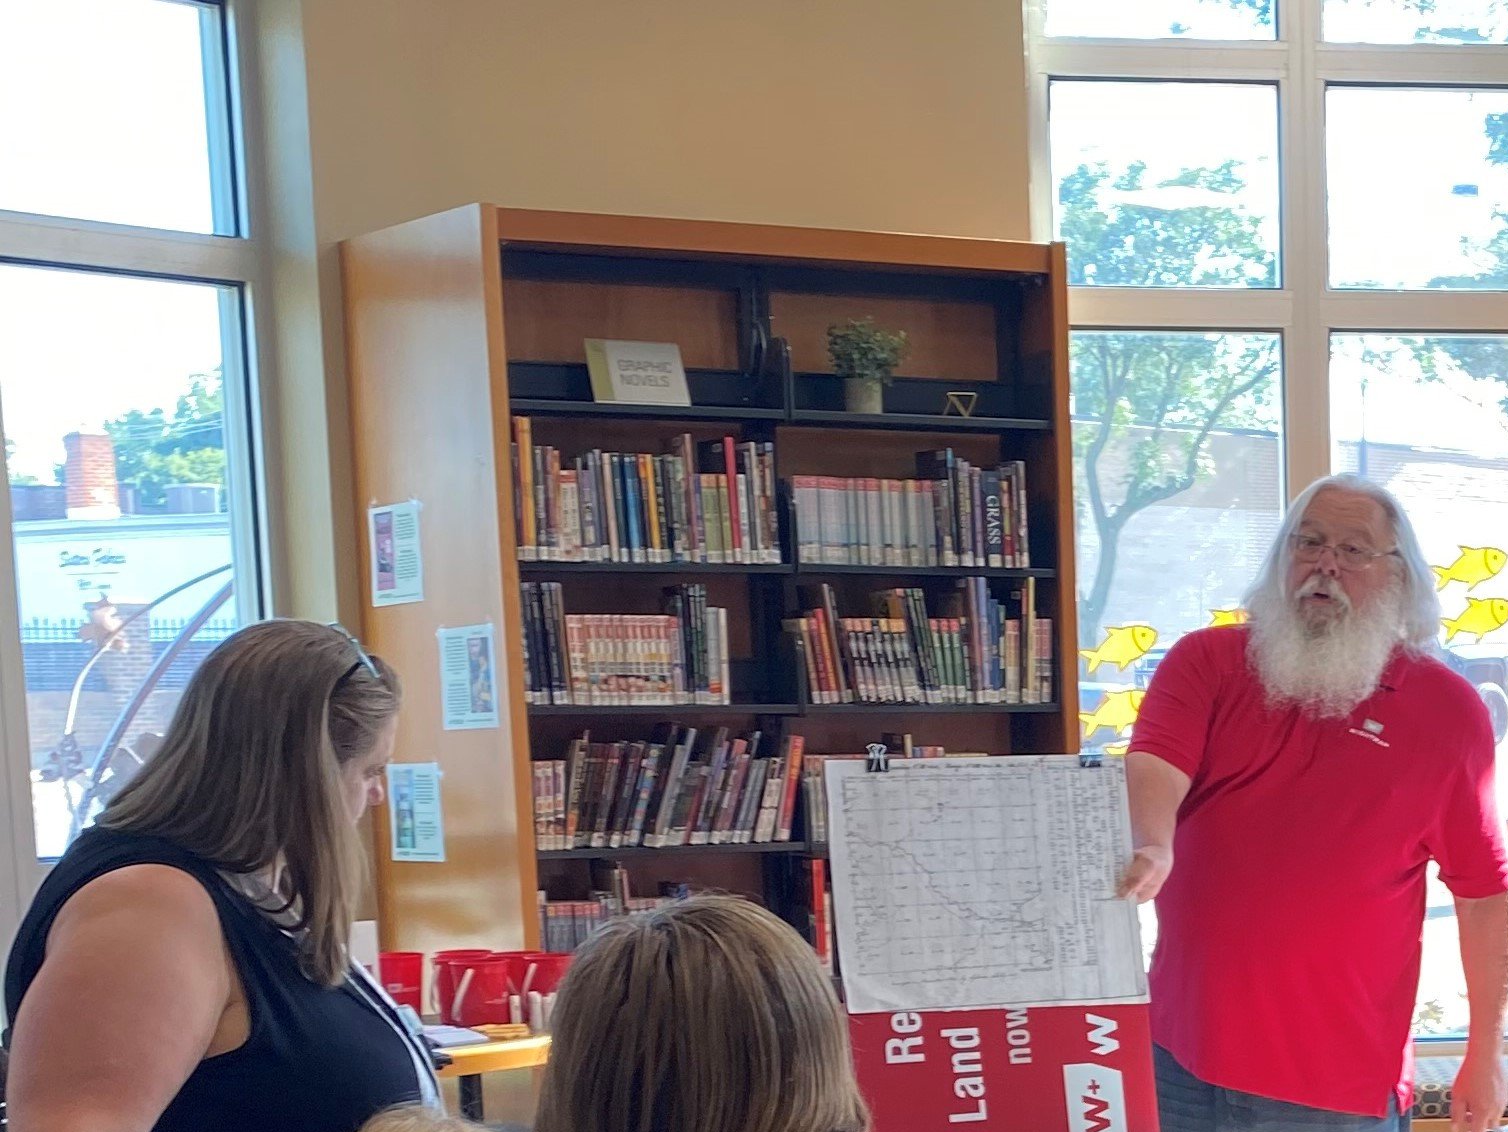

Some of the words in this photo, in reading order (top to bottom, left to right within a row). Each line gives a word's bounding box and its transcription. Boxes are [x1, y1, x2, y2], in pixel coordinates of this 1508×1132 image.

[617, 359, 673, 374] GRAPHIC
[620, 373, 670, 388] NOVELS
[985, 495, 1002, 545] GRASS
[939, 1027, 987, 1123] Land
